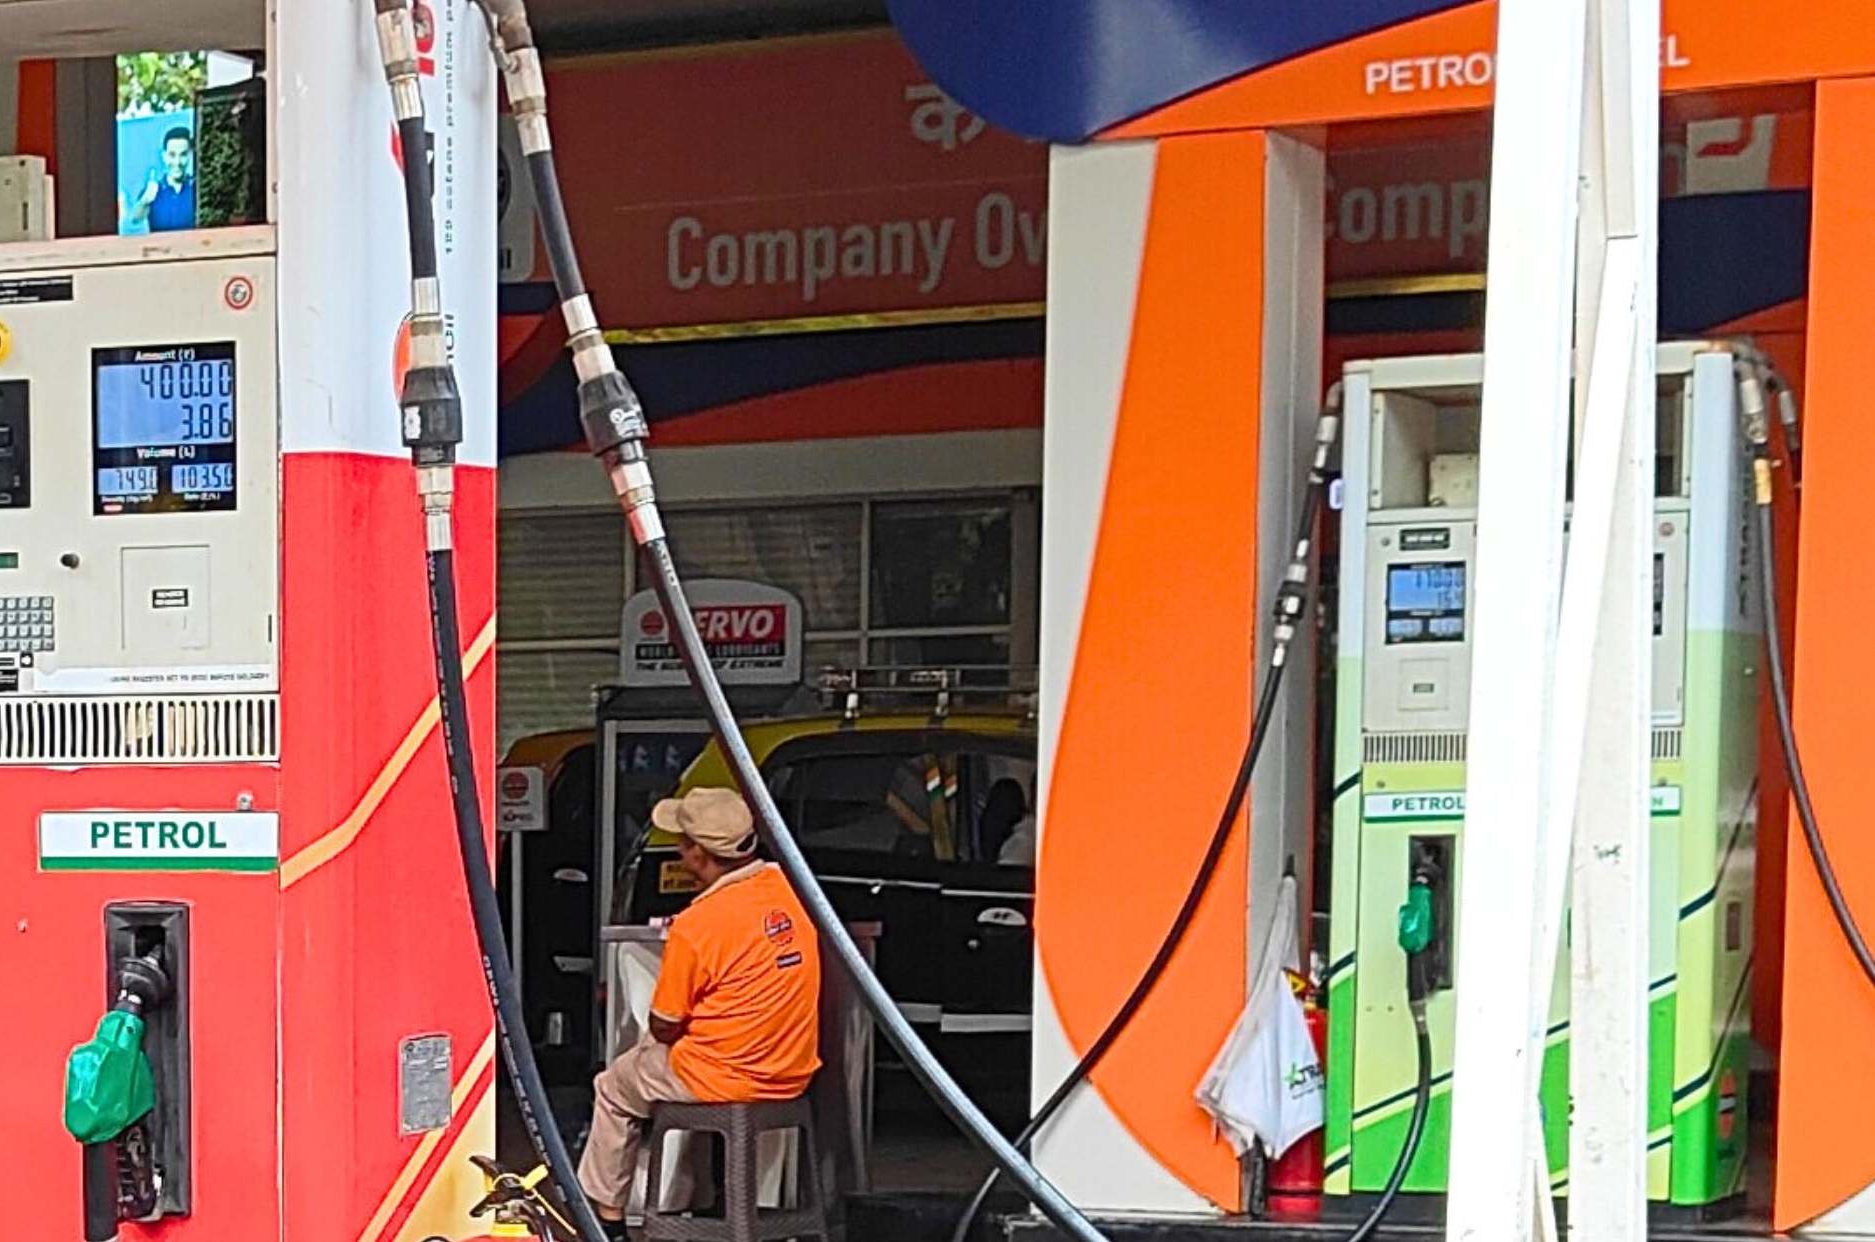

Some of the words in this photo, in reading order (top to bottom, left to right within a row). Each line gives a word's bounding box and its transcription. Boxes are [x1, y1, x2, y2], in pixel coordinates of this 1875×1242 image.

[1365, 53, 1495, 95] PETRO
[667, 216, 955, 301] Company
[140, 362, 232, 400] 400.00
[182, 402, 232, 441] 3.86
[693, 609, 774, 640] ERVO
[89, 820, 227, 850] PETROL
